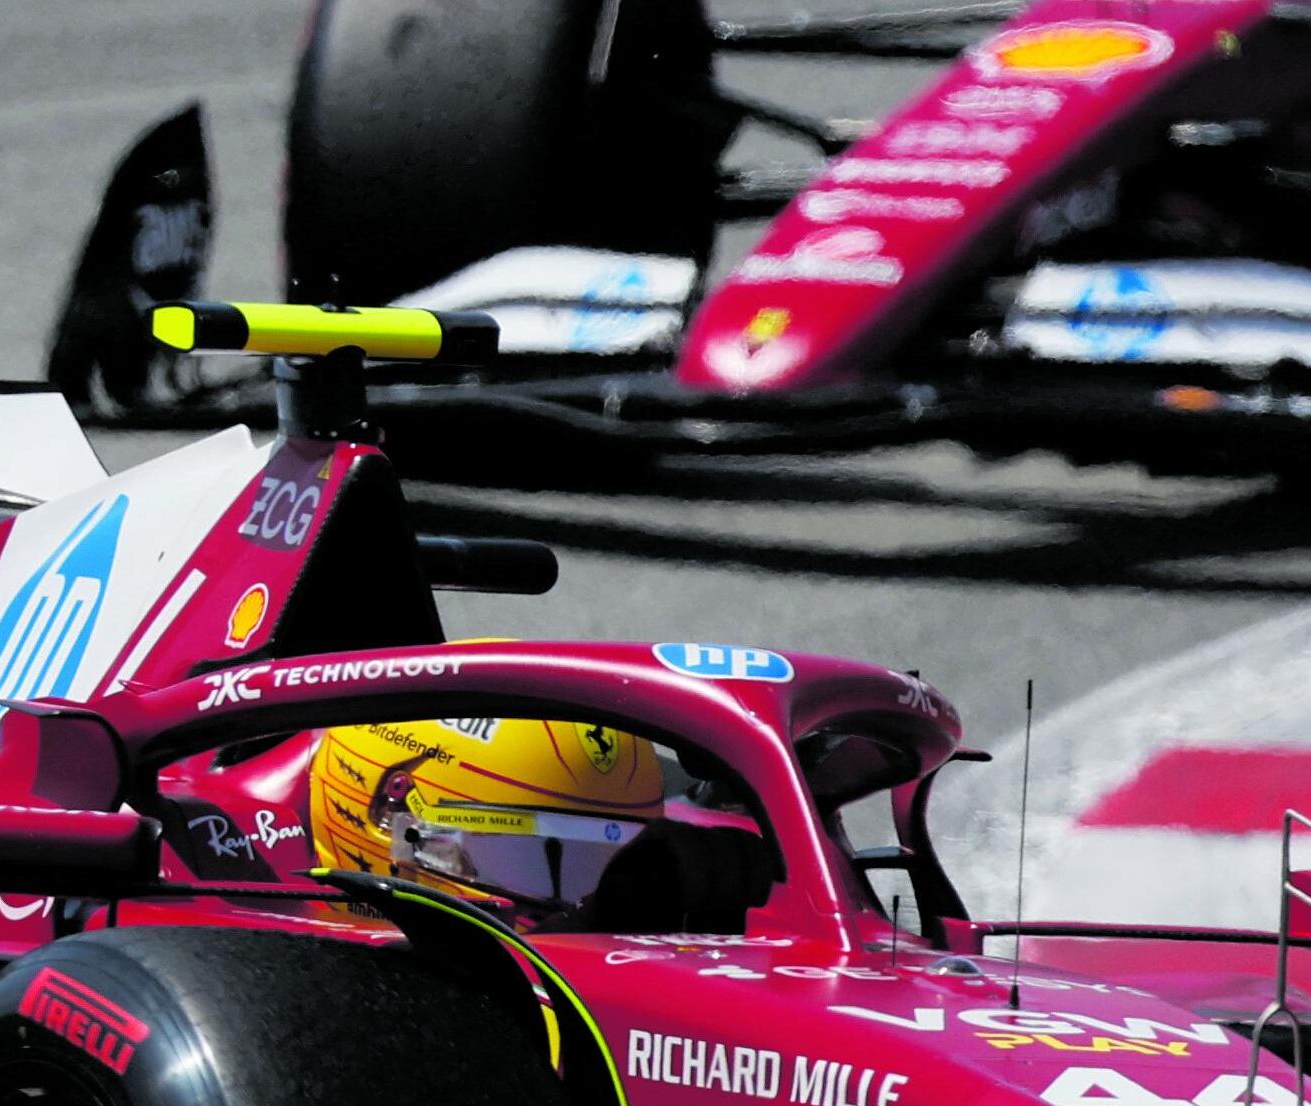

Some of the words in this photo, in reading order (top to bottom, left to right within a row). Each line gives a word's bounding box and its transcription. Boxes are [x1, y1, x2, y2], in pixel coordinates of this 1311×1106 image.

[238, 476, 321, 546] ZCG
[273, 659, 465, 688] TECHNOLOGY
[368, 723, 456, 766] Bitdefender
[187, 809, 307, 860] Ray-Ban
[437, 815, 486, 824] RICHARD
[488, 816, 524, 826] MILLE
[18, 965, 151, 1076] PIRELLI
[826, 1006, 1231, 1045] VGW
[628, 1028, 781, 1100] RICHARD
[975, 1032, 1192, 1056] PLAY
